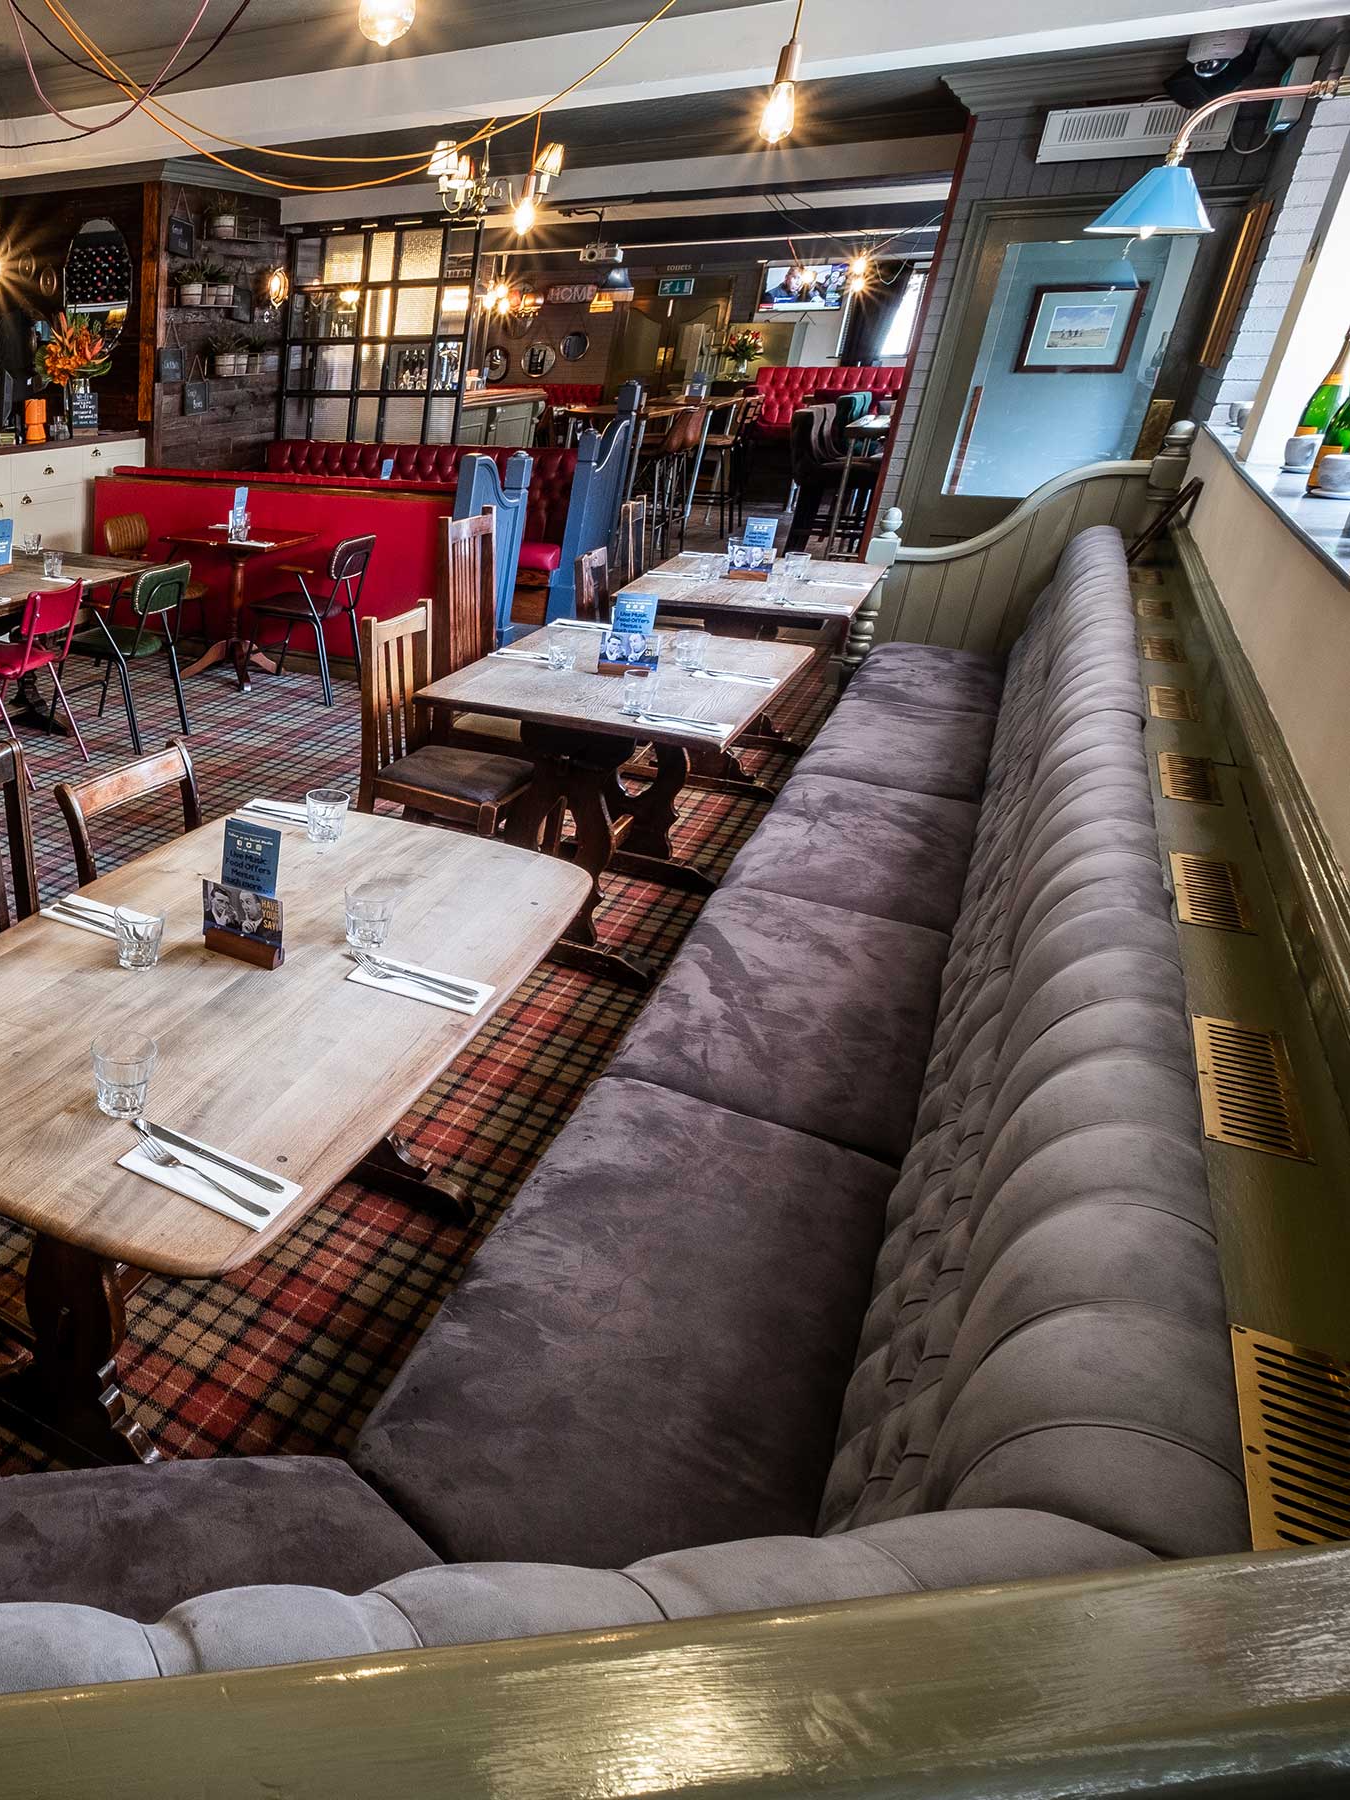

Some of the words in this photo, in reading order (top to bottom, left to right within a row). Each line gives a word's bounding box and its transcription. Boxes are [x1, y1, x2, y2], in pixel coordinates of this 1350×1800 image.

[230, 850, 244, 860] Live
[245, 853, 268, 866] Music
[225, 857, 244, 869] Food
[244, 862, 272, 876] Offers
[261, 899, 280, 912] HAVE
